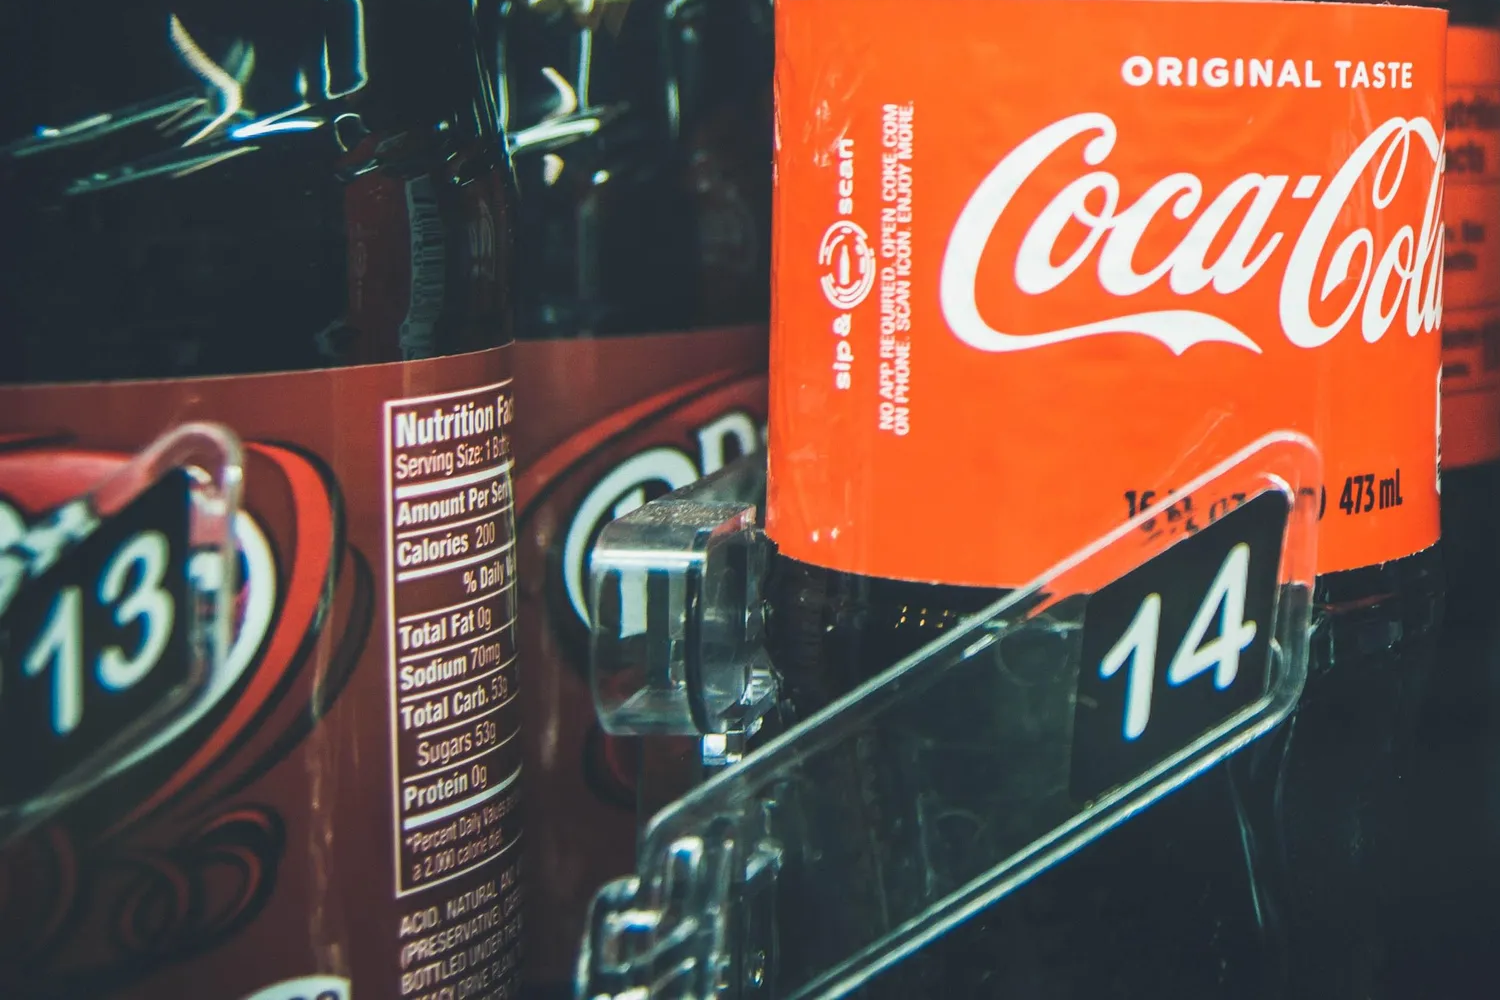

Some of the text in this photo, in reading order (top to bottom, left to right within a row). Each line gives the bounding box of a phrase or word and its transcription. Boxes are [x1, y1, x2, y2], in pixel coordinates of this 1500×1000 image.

[1121, 56, 1412, 89] ORIGINAL TASTE
[897, 164, 913, 223] ENJOY
[881, 207, 897, 257] OPEN
[833, 139, 854, 390] sip & scan
[896, 281, 911, 331] SCAN
[879, 362, 894, 399] APP
[395, 401, 494, 448] Nutrition
[879, 402, 894, 430] NO
[894, 407, 910, 436] ON
[396, 450, 453, 479] Serving
[457, 443, 483, 469] Size:
[396, 491, 465, 527] Amount
[468, 487, 489, 511] Per
[1339, 474, 1375, 515] 473
[1379, 467, 1403, 511] mL
[398, 522, 495, 567] Calories 200
[464, 570, 478, 593] %
[480, 560, 505, 589] Daily
[23, 530, 175, 735] 13
[399, 606, 491, 650] Total Fat 0g
[1099, 542, 1257, 740] 14
[400, 643, 500, 691] Sodium 70mg
[401, 696, 449, 730] Total
[453, 685, 489, 716] Carb.
[417, 721, 496, 766] Sugars 53g
[404, 772, 468, 811] Protein
[472, 764, 487, 790] 0g
[401, 952, 467, 996] BOTTLED
